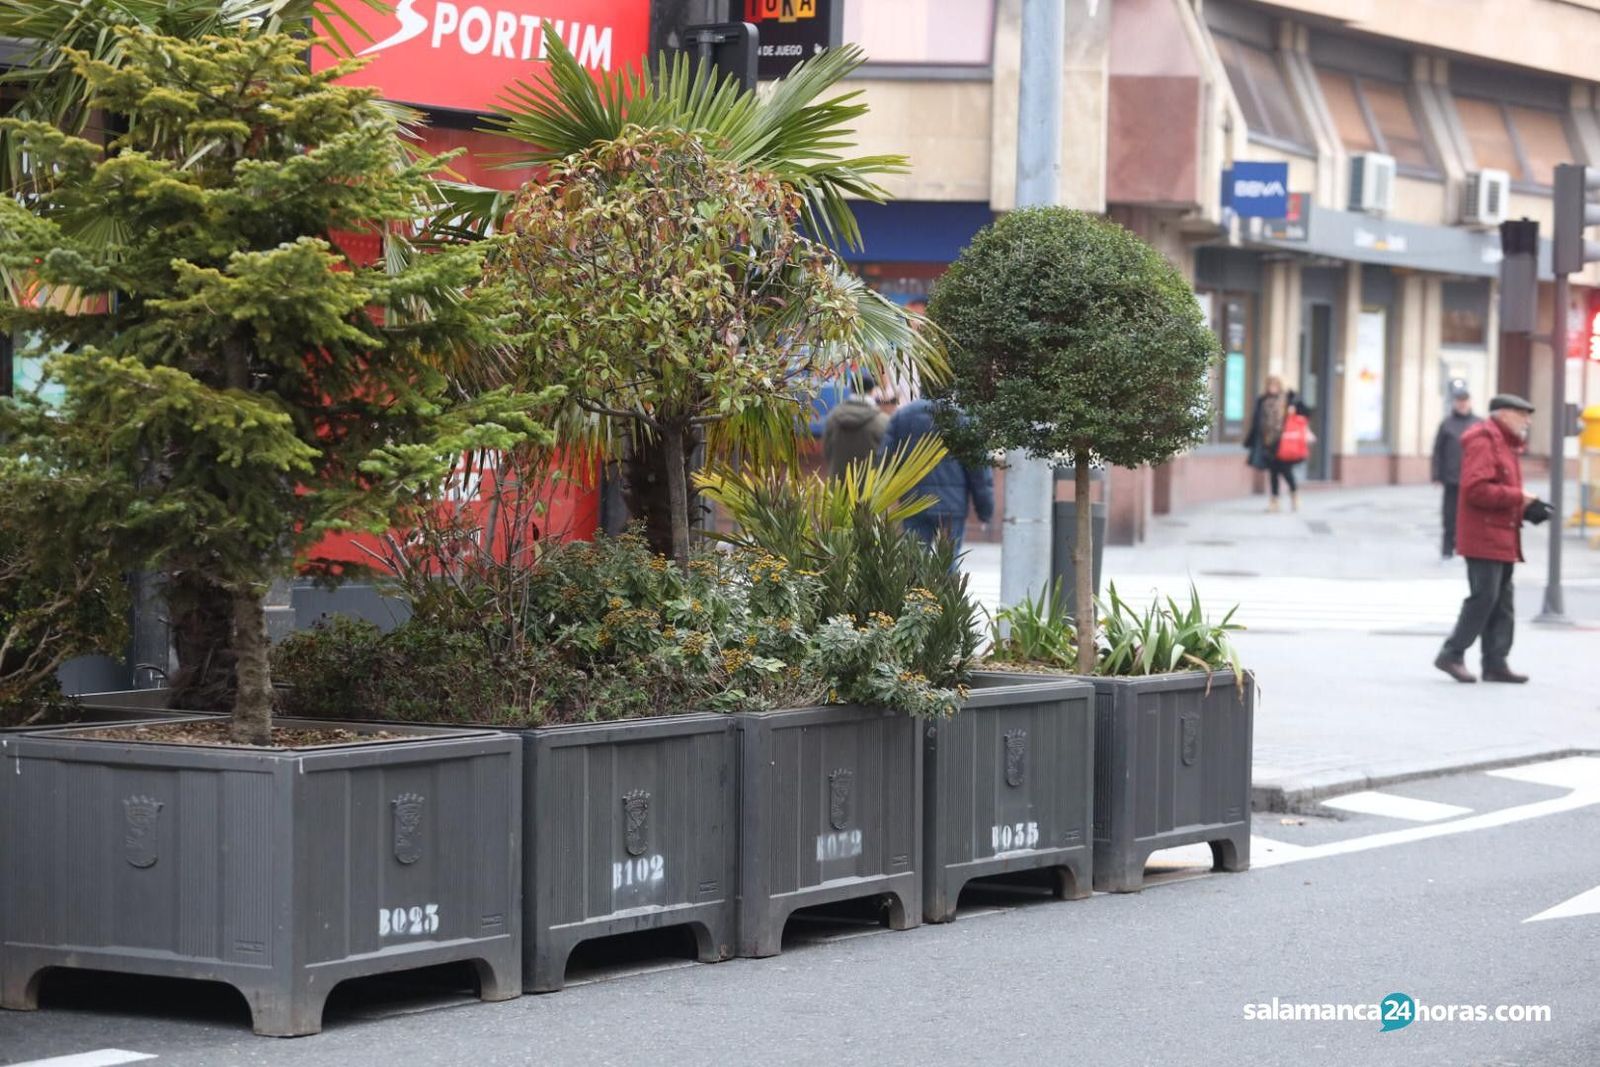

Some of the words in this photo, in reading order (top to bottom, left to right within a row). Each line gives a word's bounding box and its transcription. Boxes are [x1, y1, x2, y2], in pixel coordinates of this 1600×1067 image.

[763, 45, 774, 56] DE
[775, 44, 802, 56] JUEGO
[1234, 180, 1285, 197] BBVA
[613, 855, 664, 889] B102
